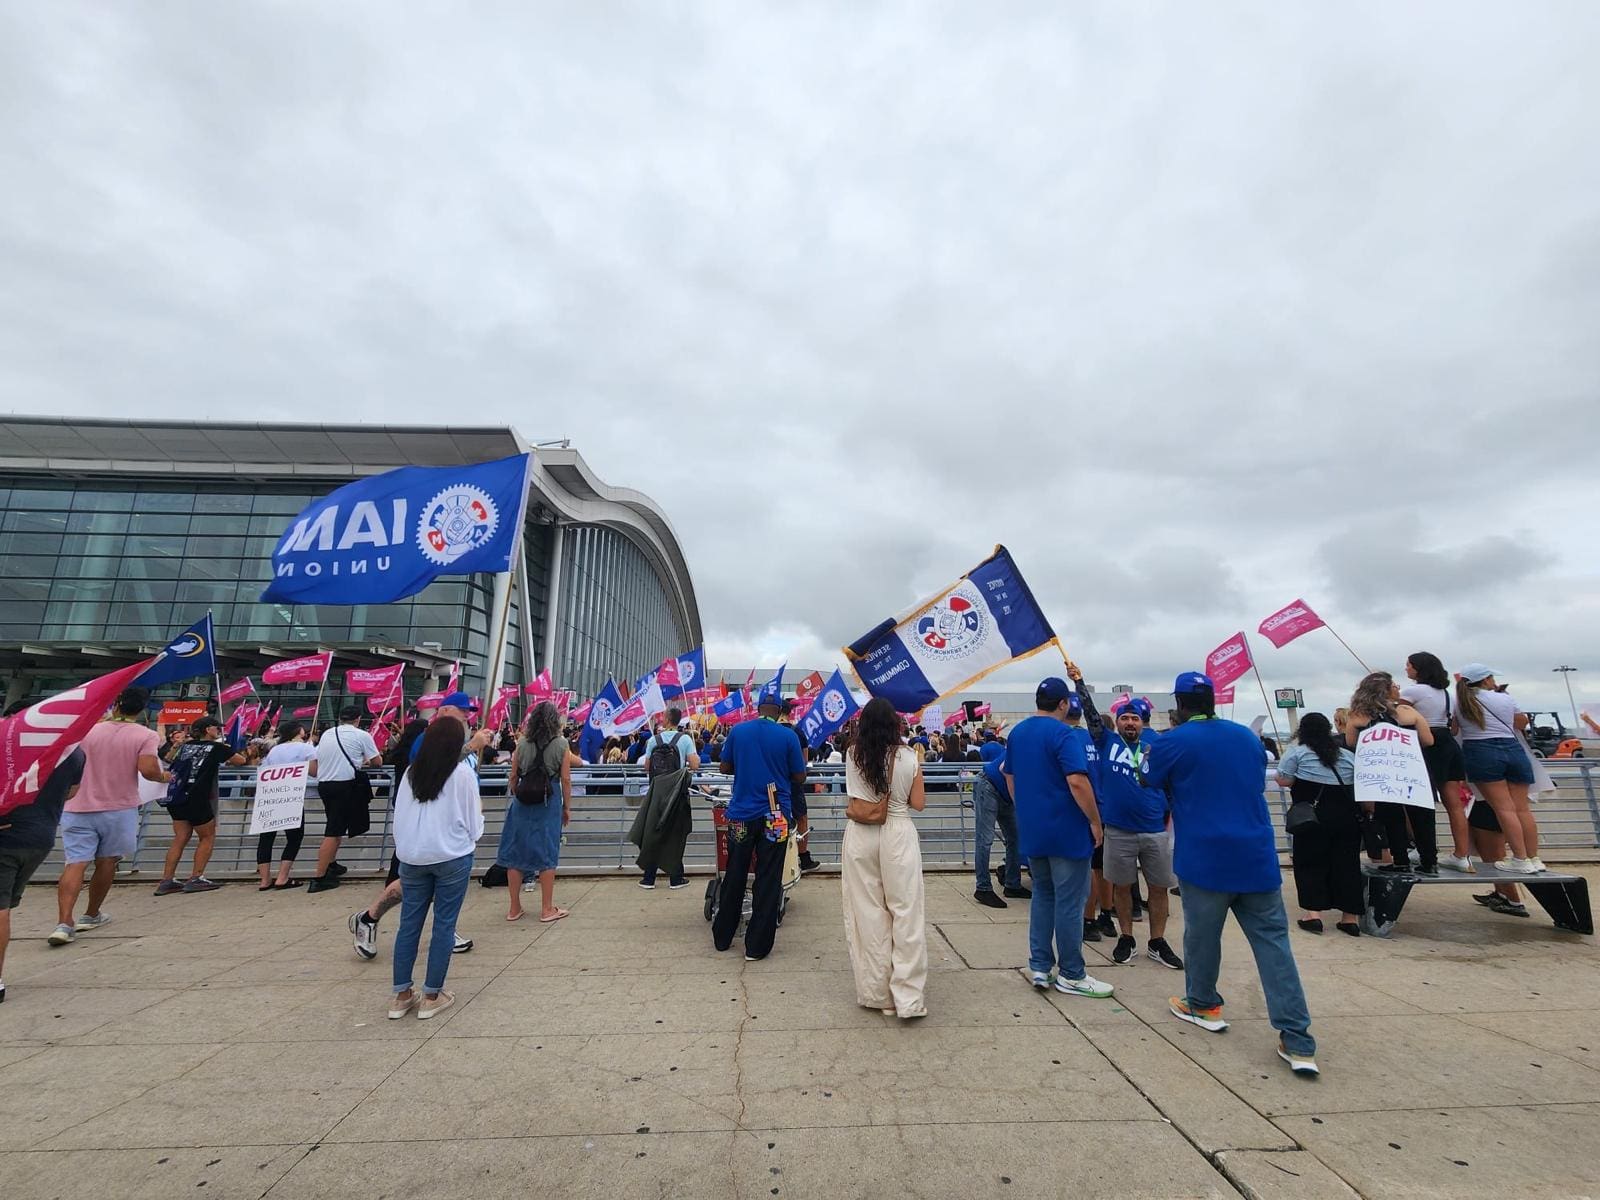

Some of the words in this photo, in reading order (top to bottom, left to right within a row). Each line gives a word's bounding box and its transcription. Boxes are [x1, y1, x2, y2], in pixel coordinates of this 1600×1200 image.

[1361, 728, 1411, 745] CUPE
[1362, 758, 1407, 768] SERVICE
[261, 766, 304, 781] CUPE
[258, 808, 275, 820] NOT
